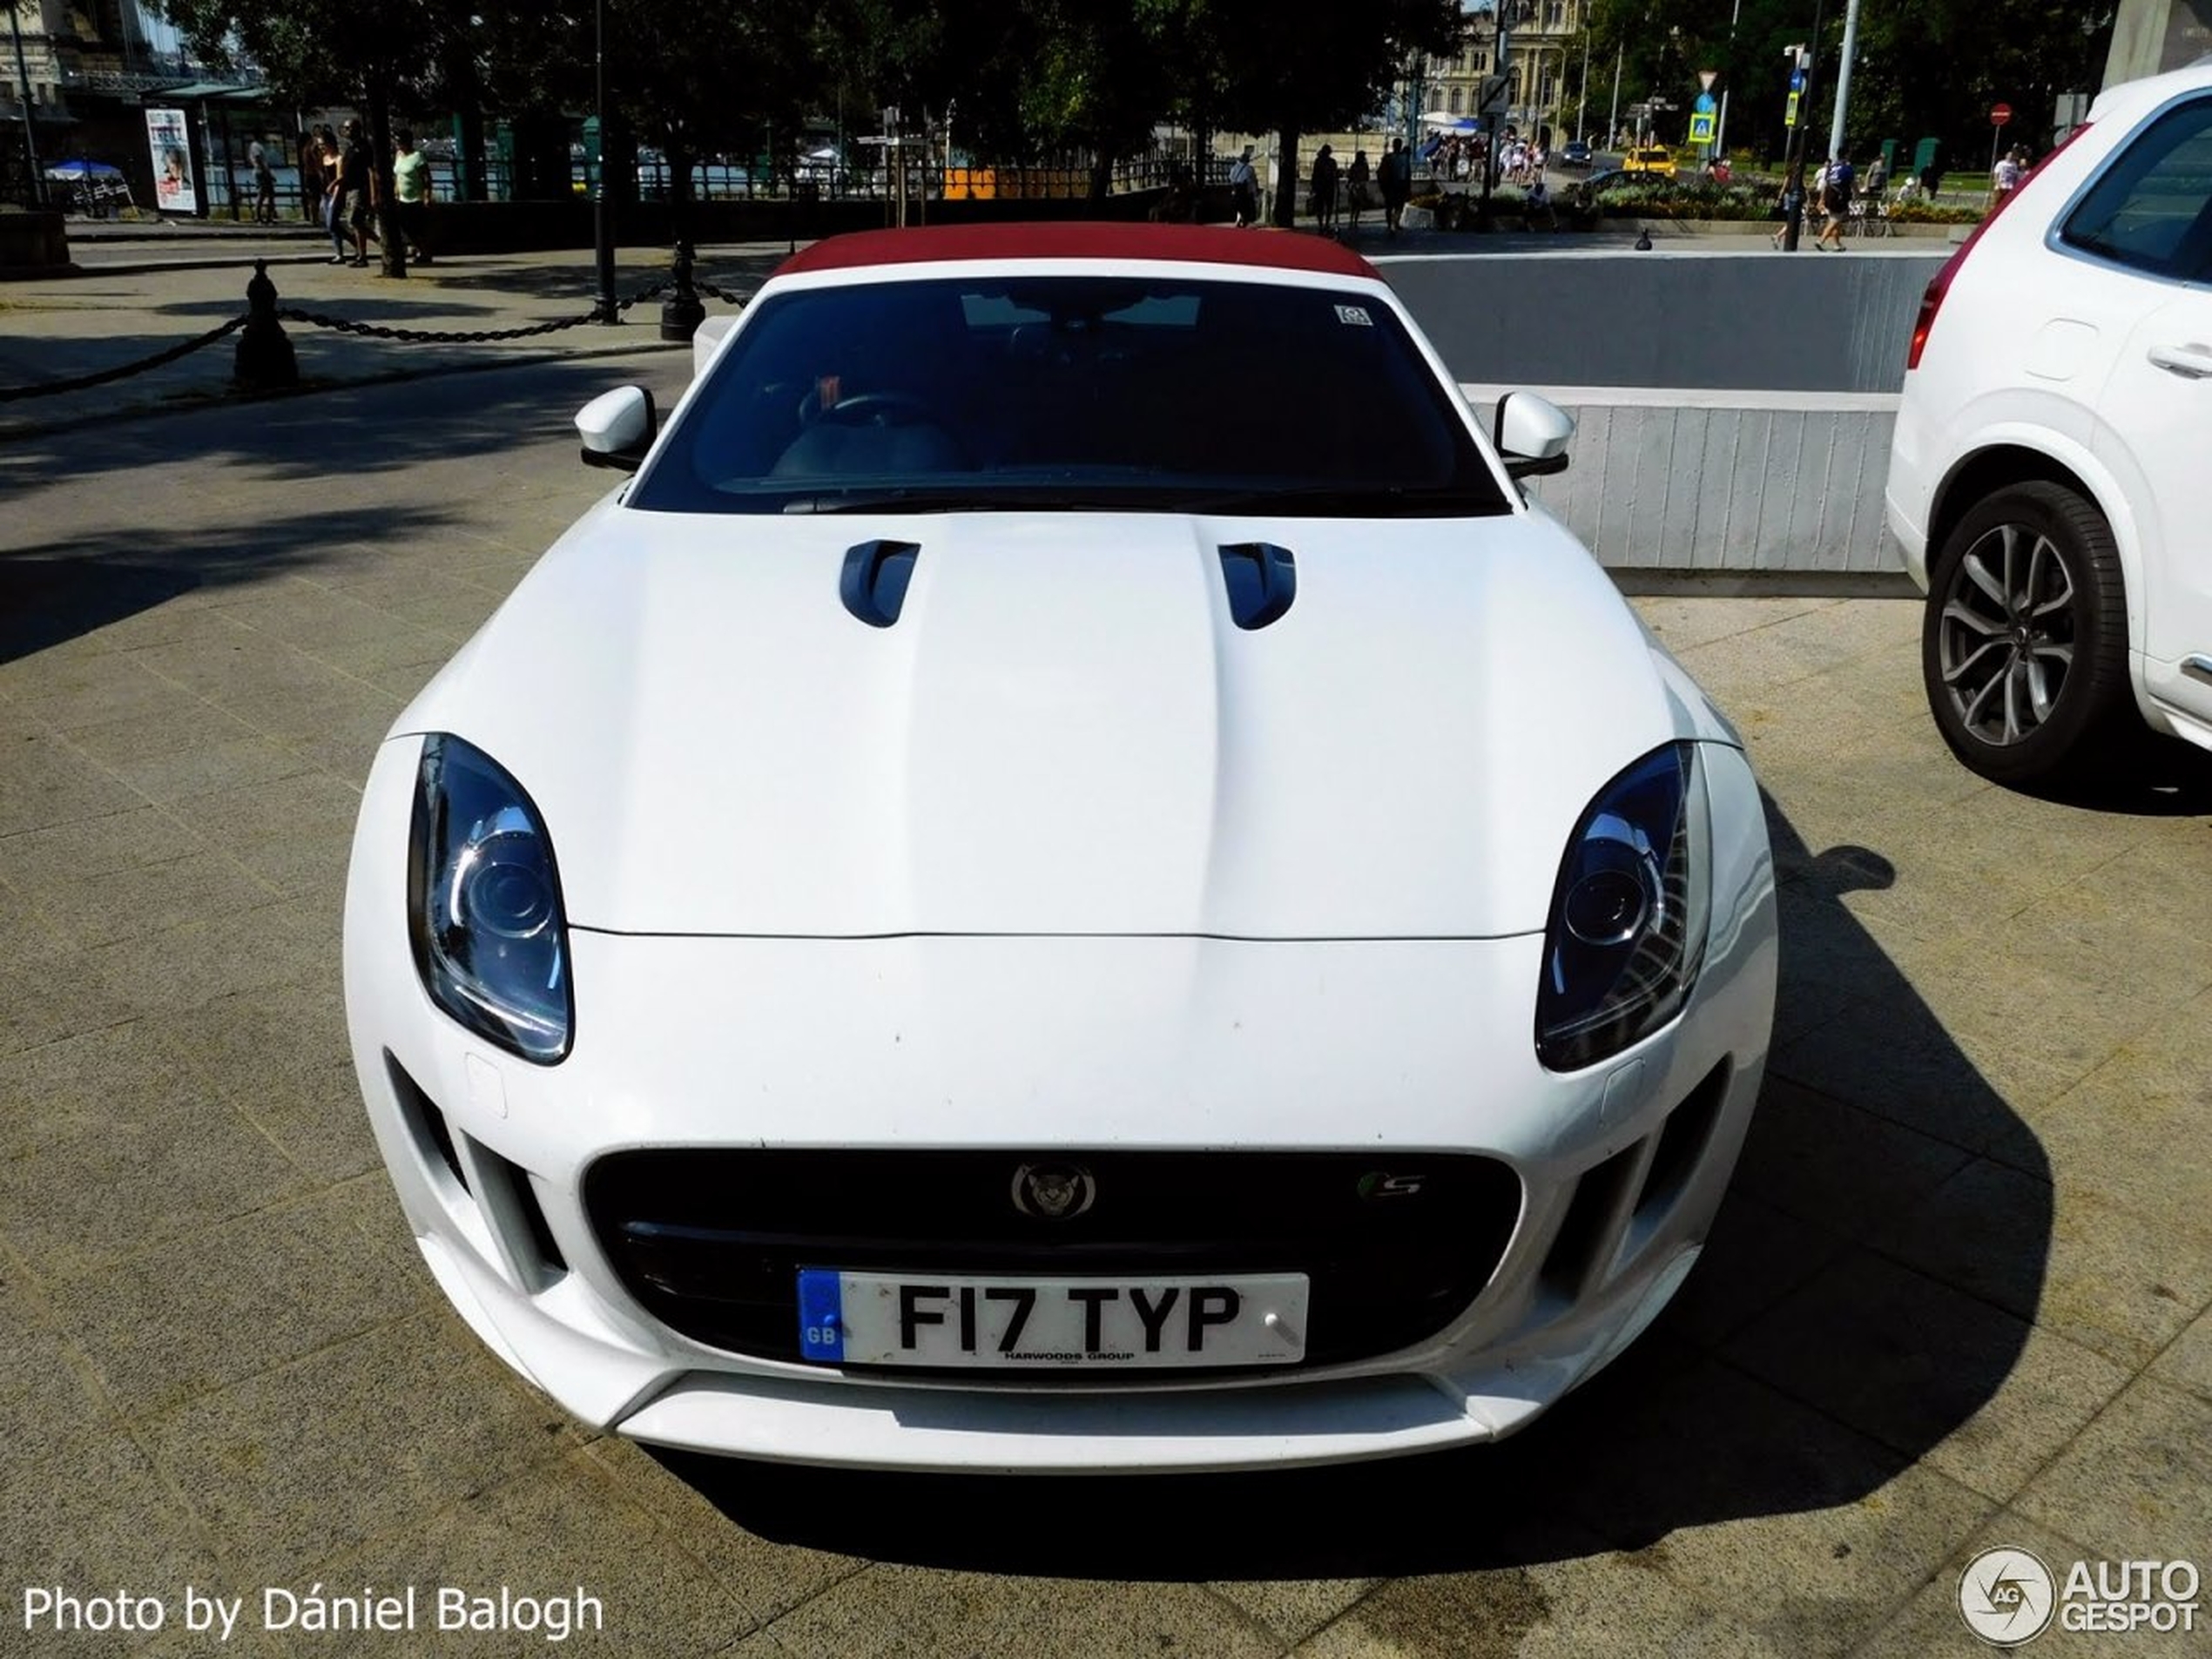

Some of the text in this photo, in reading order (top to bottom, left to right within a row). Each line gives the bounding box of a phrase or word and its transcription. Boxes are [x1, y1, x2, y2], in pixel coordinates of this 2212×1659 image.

[899, 1285, 1241, 1352] F17 TYP
[806, 1326, 836, 1345] GB
[1004, 1352, 1135, 1360] HARWOODS GROUP
